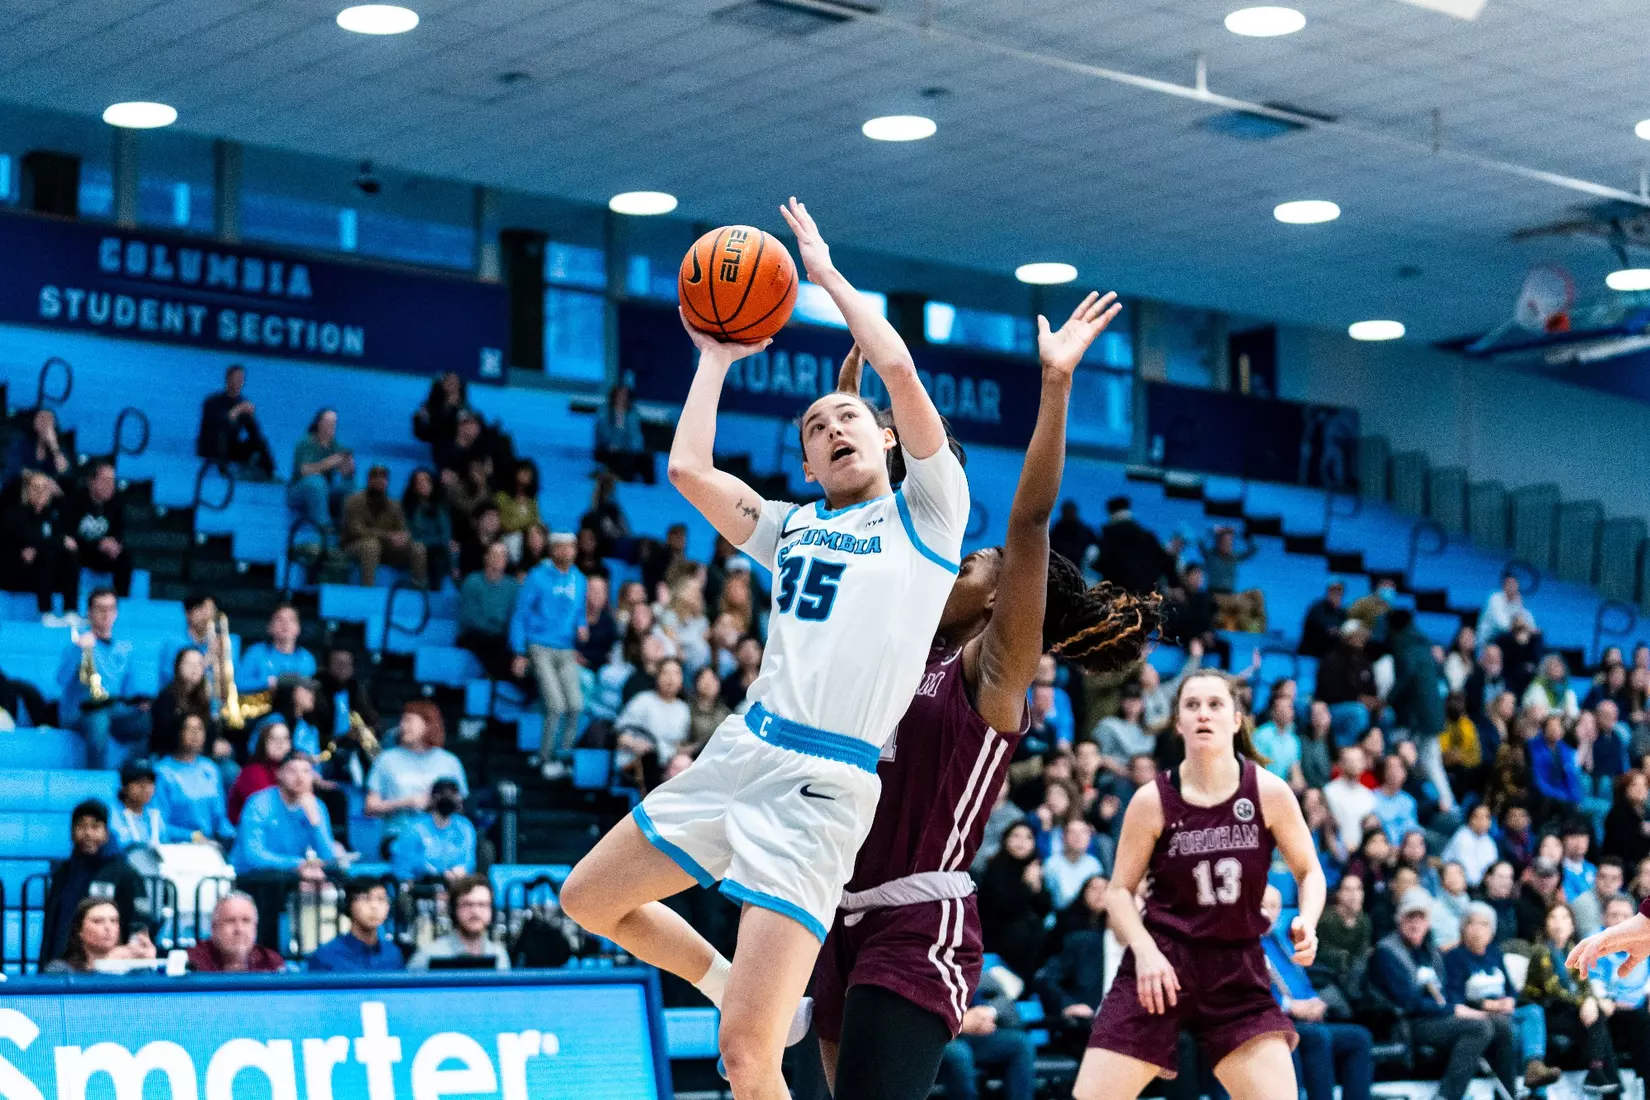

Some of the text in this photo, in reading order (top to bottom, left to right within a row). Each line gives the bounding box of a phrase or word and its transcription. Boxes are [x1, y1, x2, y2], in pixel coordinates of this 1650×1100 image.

[99, 237, 312, 297] COLUMBIA
[39, 284, 366, 356] STUDENT SECTION
[776, 556, 847, 622] 35
[760, 716, 773, 738] C
[1168, 824, 1260, 857] FORDHAM
[1192, 857, 1243, 906] 13
